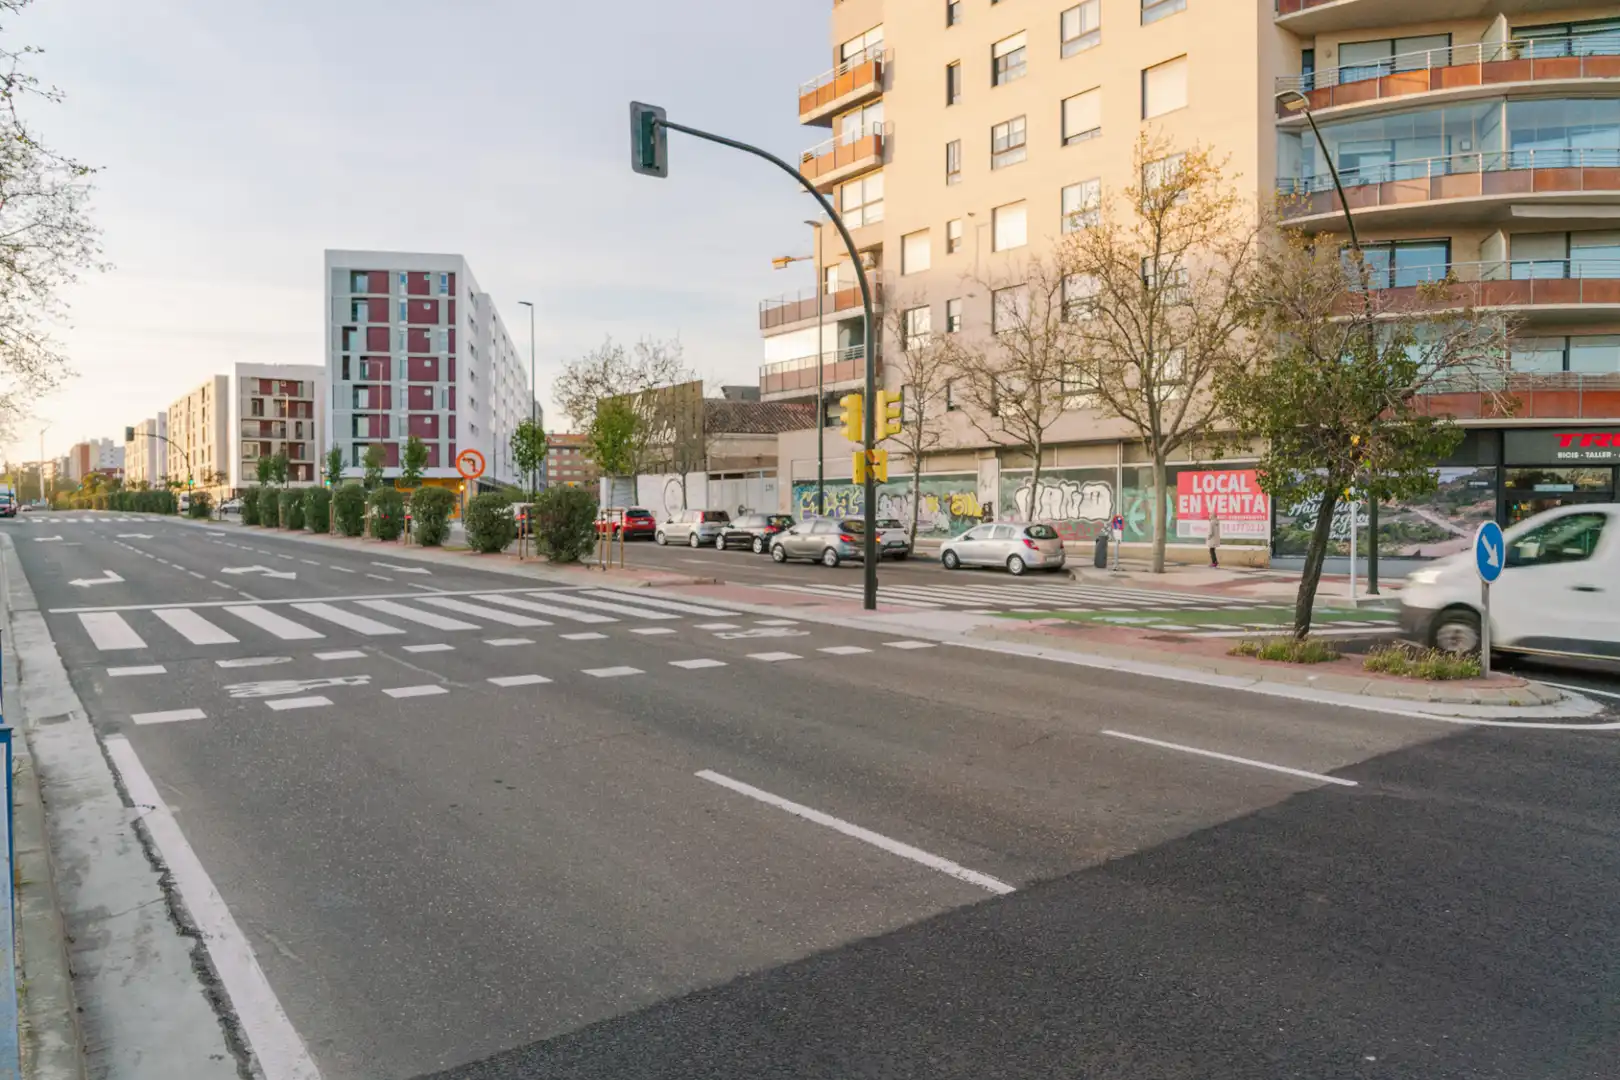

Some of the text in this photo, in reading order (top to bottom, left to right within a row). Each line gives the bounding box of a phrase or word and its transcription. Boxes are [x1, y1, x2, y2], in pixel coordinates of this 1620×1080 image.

[1557, 451, 1579, 459] BICIS
[1585, 450, 1612, 459] TALLER
[1192, 473, 1251, 494] LOCAL
[1178, 493, 1266, 514] EN VENTA
